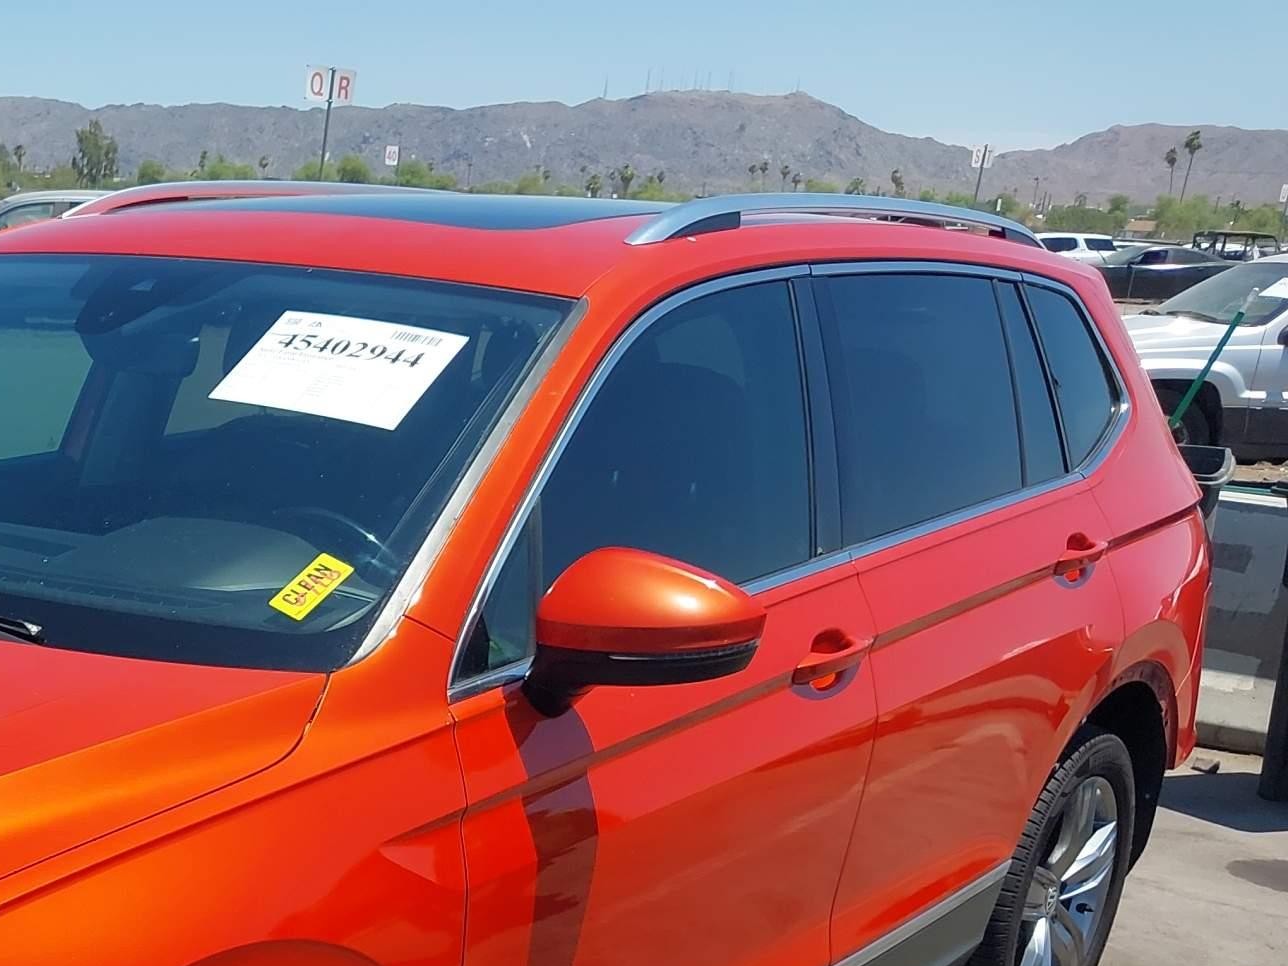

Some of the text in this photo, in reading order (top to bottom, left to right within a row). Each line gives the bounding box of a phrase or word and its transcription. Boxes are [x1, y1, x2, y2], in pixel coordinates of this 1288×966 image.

[310, 71, 324, 97] Q
[337, 75, 351, 100] R
[974, 148, 981, 164] S
[277, 333, 426, 368] 45402944
[282, 563, 333, 605] CLEAN
